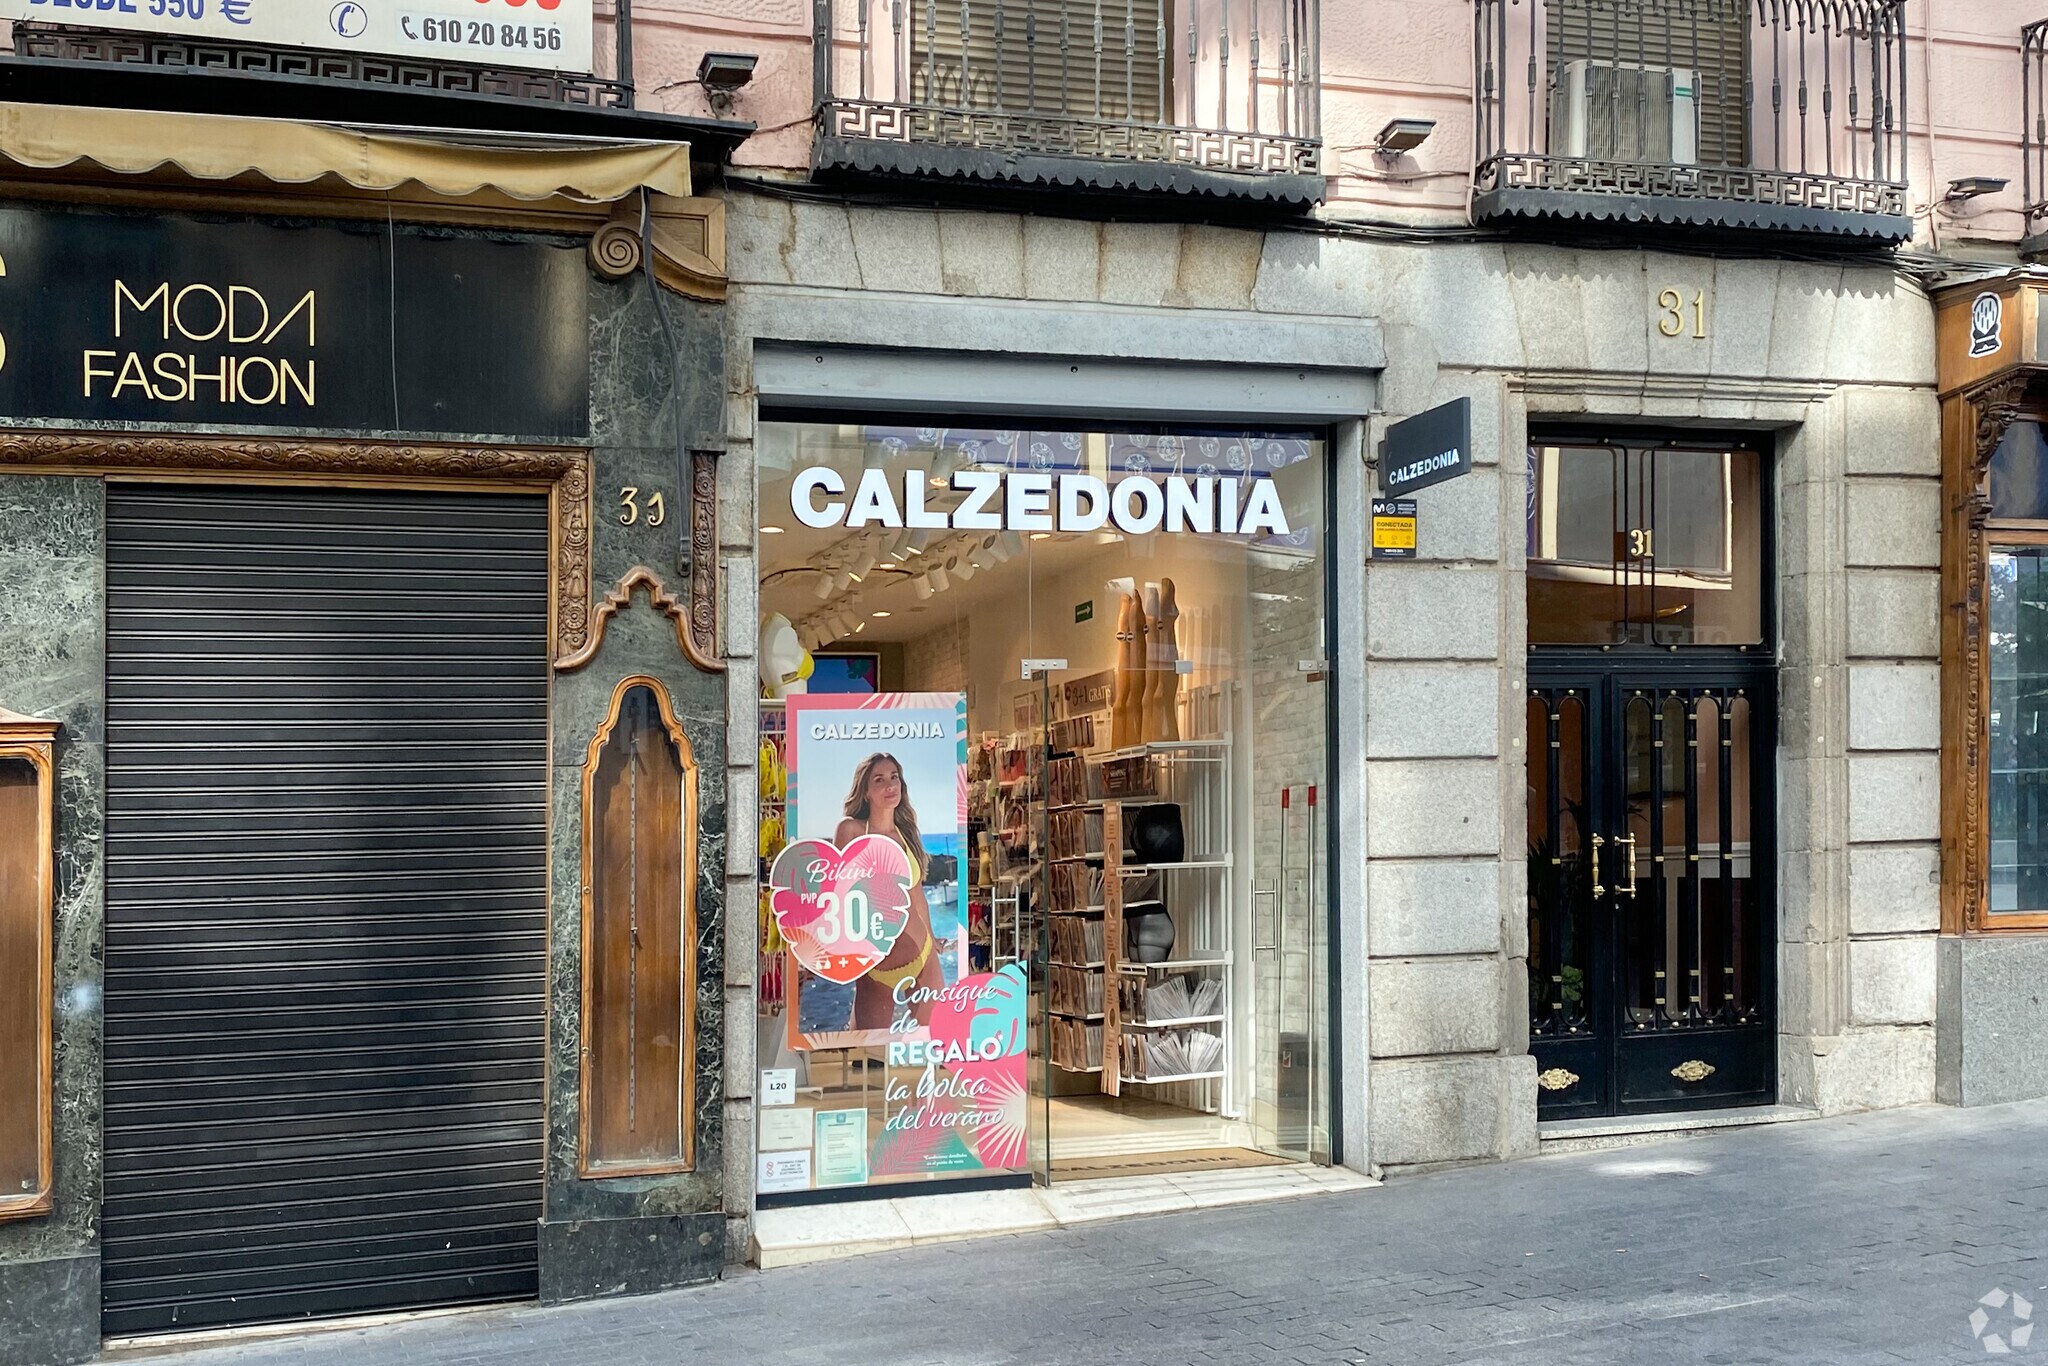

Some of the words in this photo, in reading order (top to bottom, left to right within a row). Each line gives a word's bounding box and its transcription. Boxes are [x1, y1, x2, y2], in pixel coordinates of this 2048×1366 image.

[423, 17, 461, 43] 610
[467, 21, 495, 46] 20
[500, 24, 528, 48] 84
[533, 27, 561, 50] 56
[115, 279, 315, 346] MODA
[1658, 288, 1706, 339] 31
[84, 350, 315, 406] FASHION
[1389, 448, 1460, 485] CALZEDONIA
[620, 486, 665, 526] 31
[790, 465, 1291, 535] CALZEDONIA
[1630, 529, 1655, 558] 31
[810, 722, 945, 741] CALZEDONIA
[806, 859, 877, 883] Bikini
[801, 892, 818, 904] PVP
[892, 975, 998, 1012] Consigue
[889, 1009, 921, 1035] de
[770, 1082, 787, 1090] L20
[885, 1076, 911, 1102] la
[916, 1068, 992, 1100] bolsa
[885, 1105, 926, 1132] del
[929, 1108, 1006, 1128] verano
